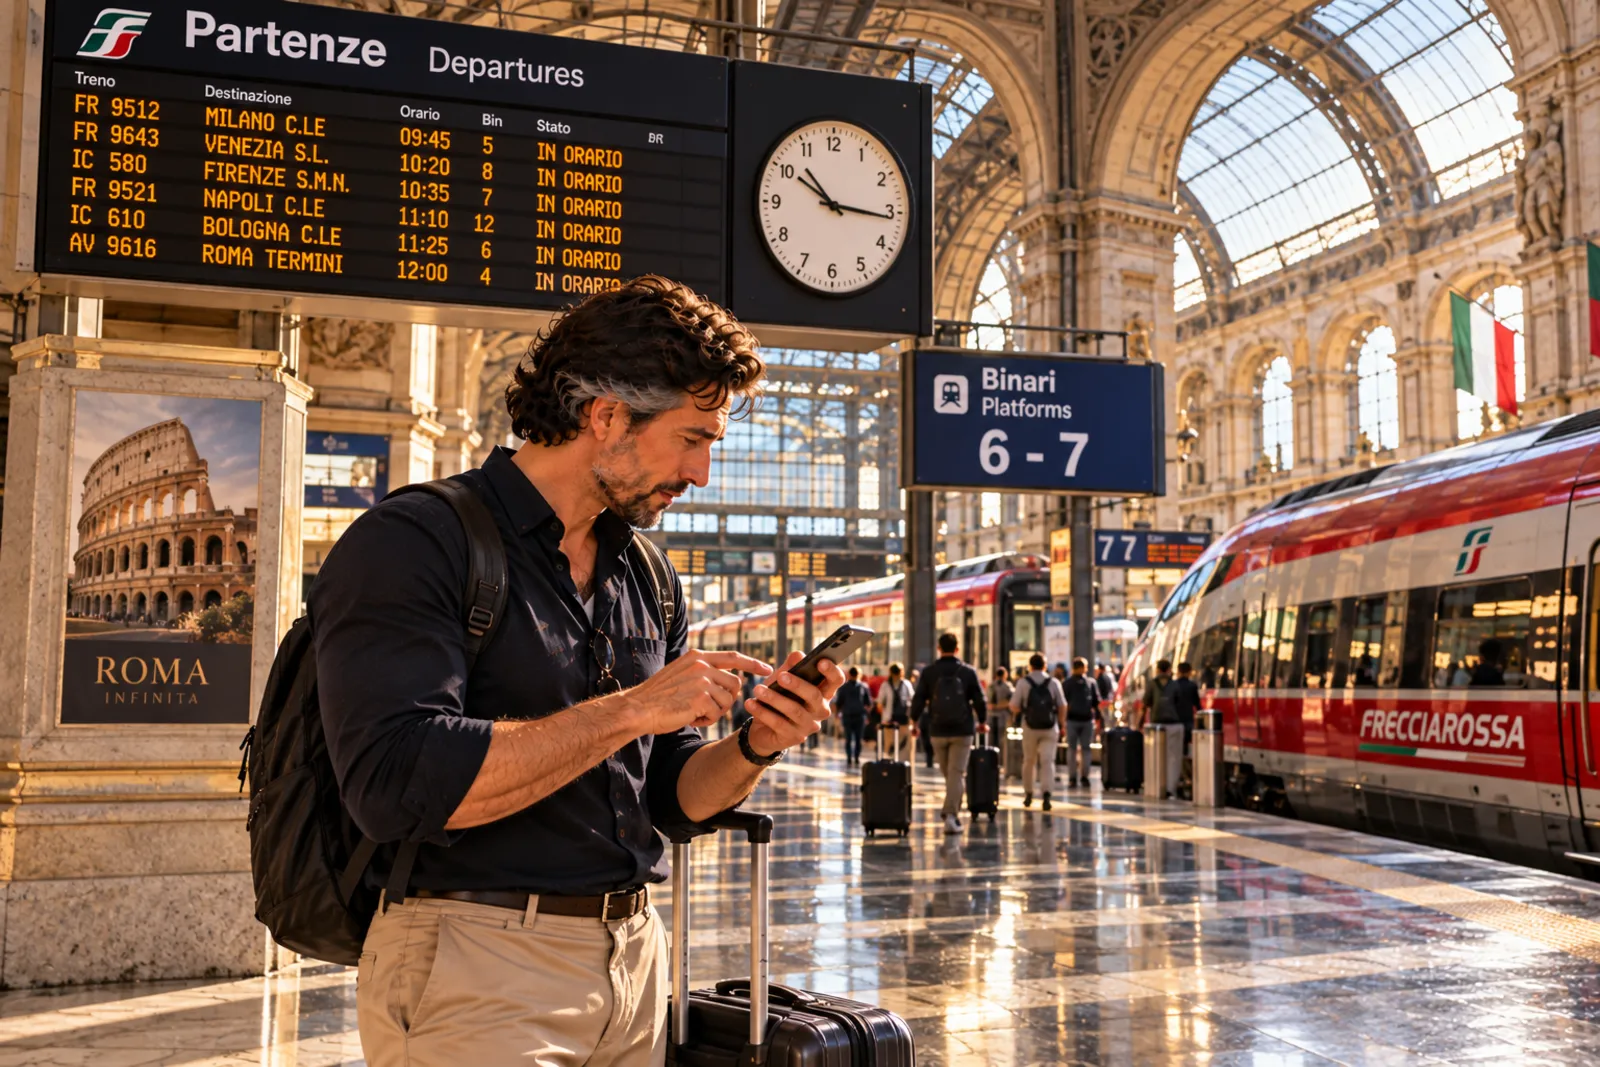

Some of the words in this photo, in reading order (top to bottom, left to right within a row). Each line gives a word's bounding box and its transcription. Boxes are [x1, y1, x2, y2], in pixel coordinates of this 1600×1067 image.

[184, 9, 388, 68] Partenze
[429, 46, 584, 88] Departures
[74, 70, 116, 88] Treno
[204, 84, 292, 106] Destinazione
[399, 104, 441, 121] Orario
[482, 113, 503, 127] Bin
[536, 119, 571, 135] Stato
[74, 93, 99, 115] FR
[111, 97, 160, 121] 9512
[205, 106, 275, 132] MILANO
[285, 114, 326, 137] C.LE
[399, 126, 451, 150] 09:45
[482, 135, 494, 155] 5
[537, 141, 556, 162] IN
[563, 145, 623, 169] ORARIO
[800, 142, 812, 158] 11
[826, 135, 841, 153] 12
[73, 120, 99, 142] FR
[110, 124, 160, 148] 9643
[204, 133, 284, 160] VENEZIA
[294, 142, 329, 165] S.L.
[400, 153, 451, 176] 10:20
[481, 161, 494, 181] 8
[537, 167, 556, 188] IN
[563, 170, 623, 194] ORARIO
[72, 148, 94, 170] IC
[109, 151, 147, 174] 580
[204, 160, 287, 188] FIRENZE
[296, 169, 350, 193] S.M.N.
[399, 179, 450, 203] 10:35
[482, 187, 493, 207] 7
[536, 193, 556, 214] IN
[563, 196, 622, 220] ORARIO
[779, 163, 795, 180] 10
[876, 171, 887, 187] 2
[71, 176, 97, 198] FR
[108, 179, 157, 203] 9521
[203, 187, 274, 214] NAPOLI
[284, 195, 325, 218] C.LE
[399, 206, 449, 229] 11:10
[474, 213, 495, 233] 12
[536, 219, 555, 240] IN
[562, 222, 622, 245] ORARIO
[771, 193, 782, 210] 9
[884, 203, 895, 220] 3
[70, 203, 92, 225] IC
[107, 207, 146, 230] 610
[202, 215, 290, 243] BOLOGNA
[301, 224, 342, 247] C.LE
[398, 232, 449, 256] 11:25
[481, 240, 492, 259] 6
[535, 245, 555, 265] IN
[562, 248, 622, 271] ORARIO
[778, 226, 789, 242] 8
[875, 234, 886, 250] 4
[69, 232, 95, 254] AV
[107, 235, 157, 259] 9616
[202, 243, 254, 267] ROMA
[264, 248, 344, 274] TERMINI
[397, 259, 448, 282] 12:00
[479, 266, 492, 286] 4
[535, 271, 554, 292] IN
[800, 252, 811, 268] 7
[827, 263, 838, 279] 6
[856, 256, 866, 273] 5
[982, 366, 1056, 393] Binari
[982, 396, 1072, 420] Platforms
[979, 428, 1010, 475] 6
[1026, 452, 1044, 463] -
[1059, 431, 1089, 477] 7
[1098, 535, 1115, 562] 7
[1120, 535, 1137, 562] 7
[94, 655, 210, 686] ROMA
[104, 690, 199, 705] INFINITA
[1359, 708, 1526, 750] FRECCIAROSSA
